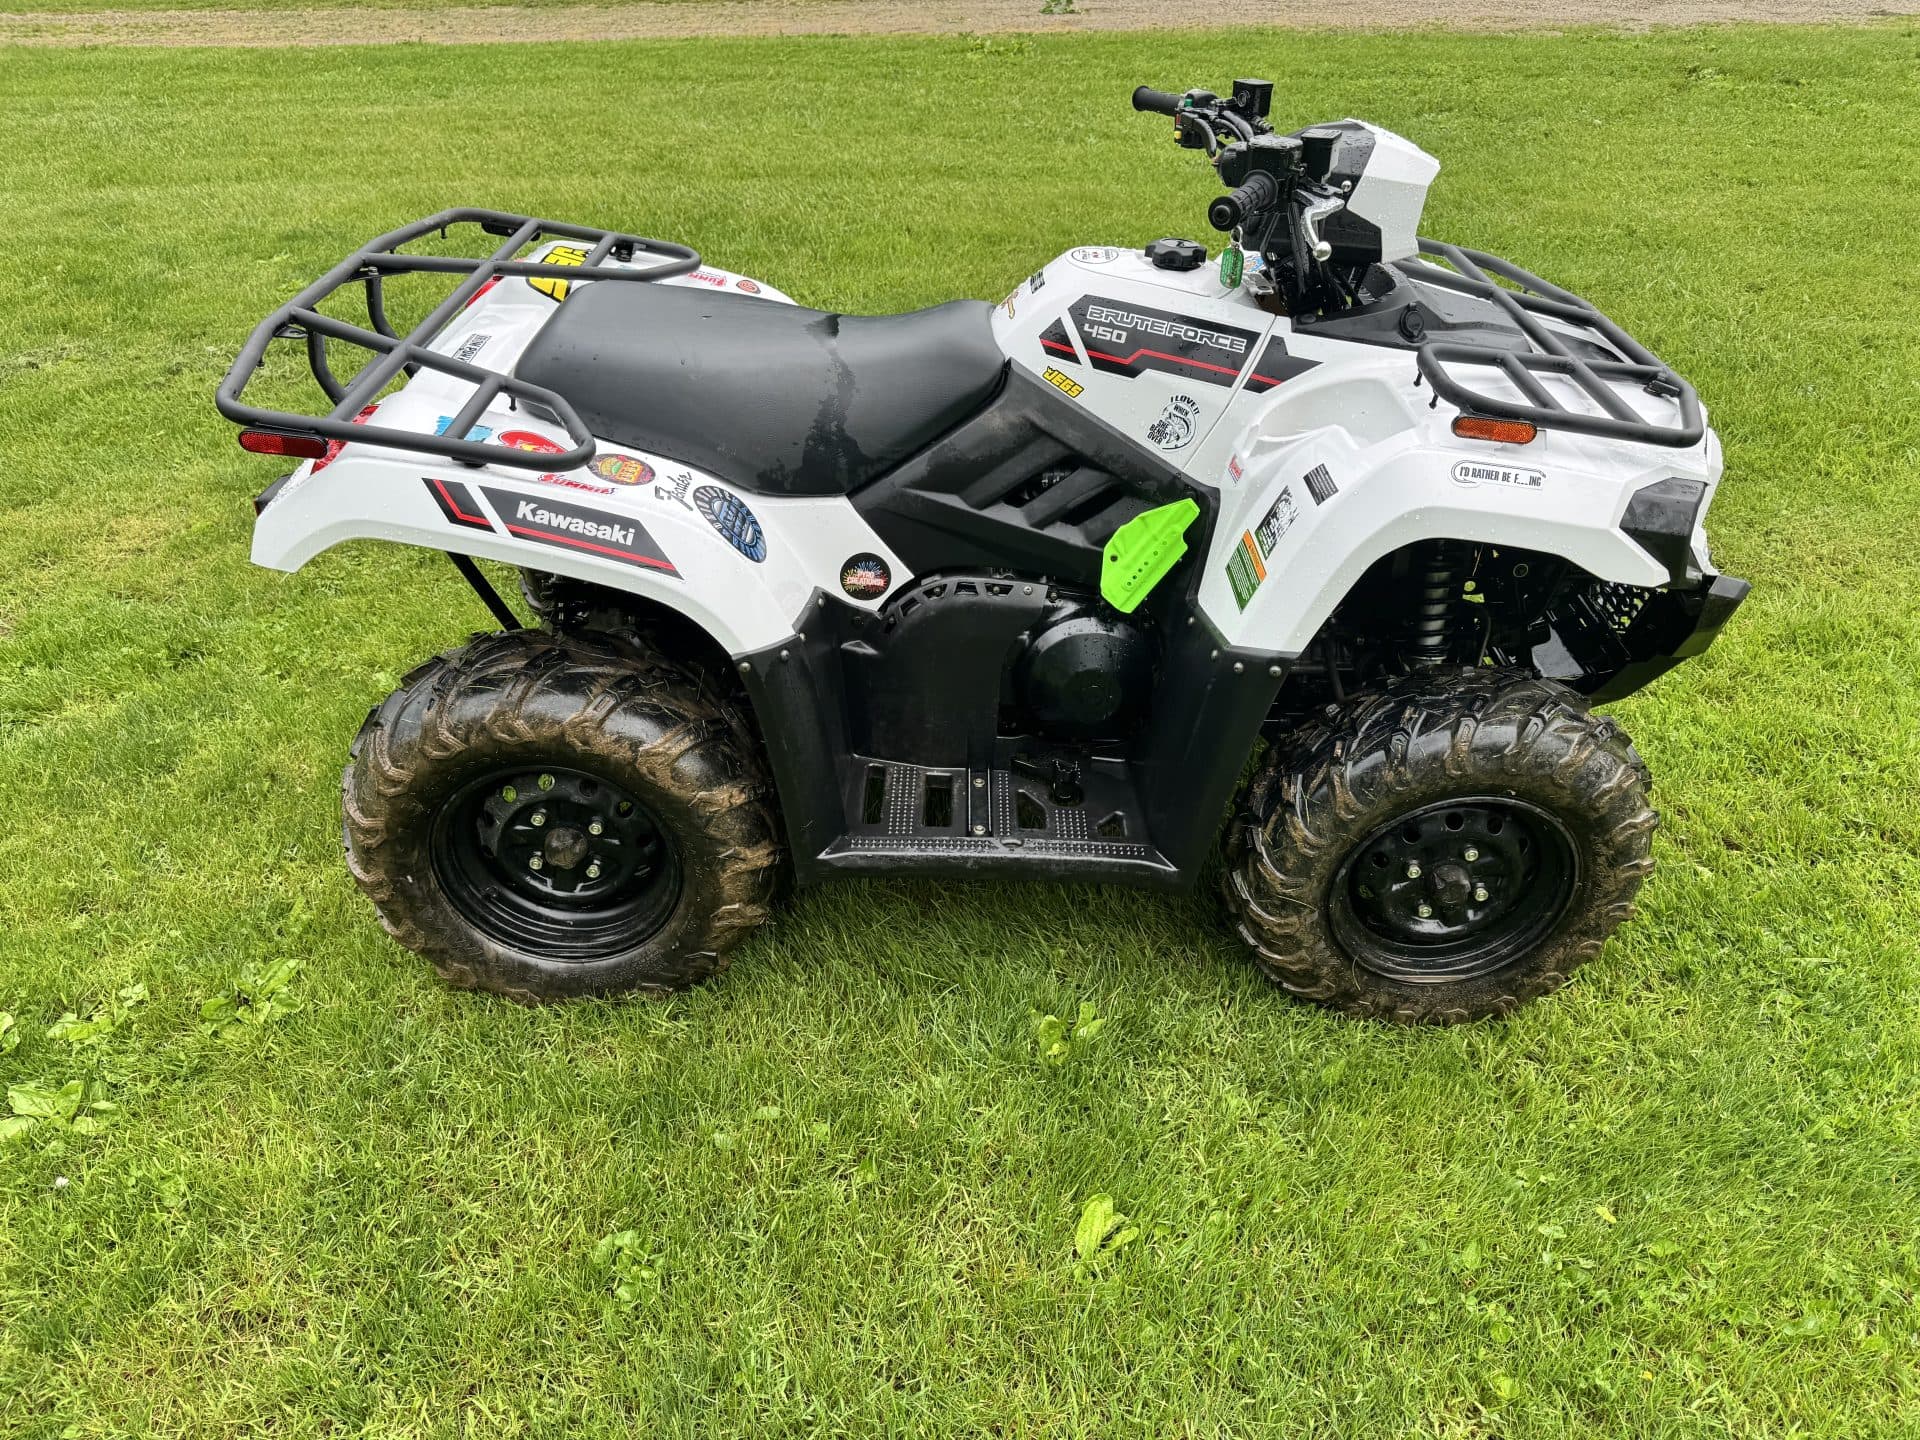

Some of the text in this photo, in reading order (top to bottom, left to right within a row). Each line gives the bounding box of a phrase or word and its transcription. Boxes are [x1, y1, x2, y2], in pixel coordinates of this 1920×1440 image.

[1083, 322, 1127, 344] 450
[1165, 321, 1247, 353] FORCE
[1043, 366, 1084, 398] JEGS
[1175, 395, 1196, 407] LOVE
[1471, 467, 1500, 481] RATHER
[1501, 471, 1512, 482] BE
[516, 500, 635, 546] Kawasaki
